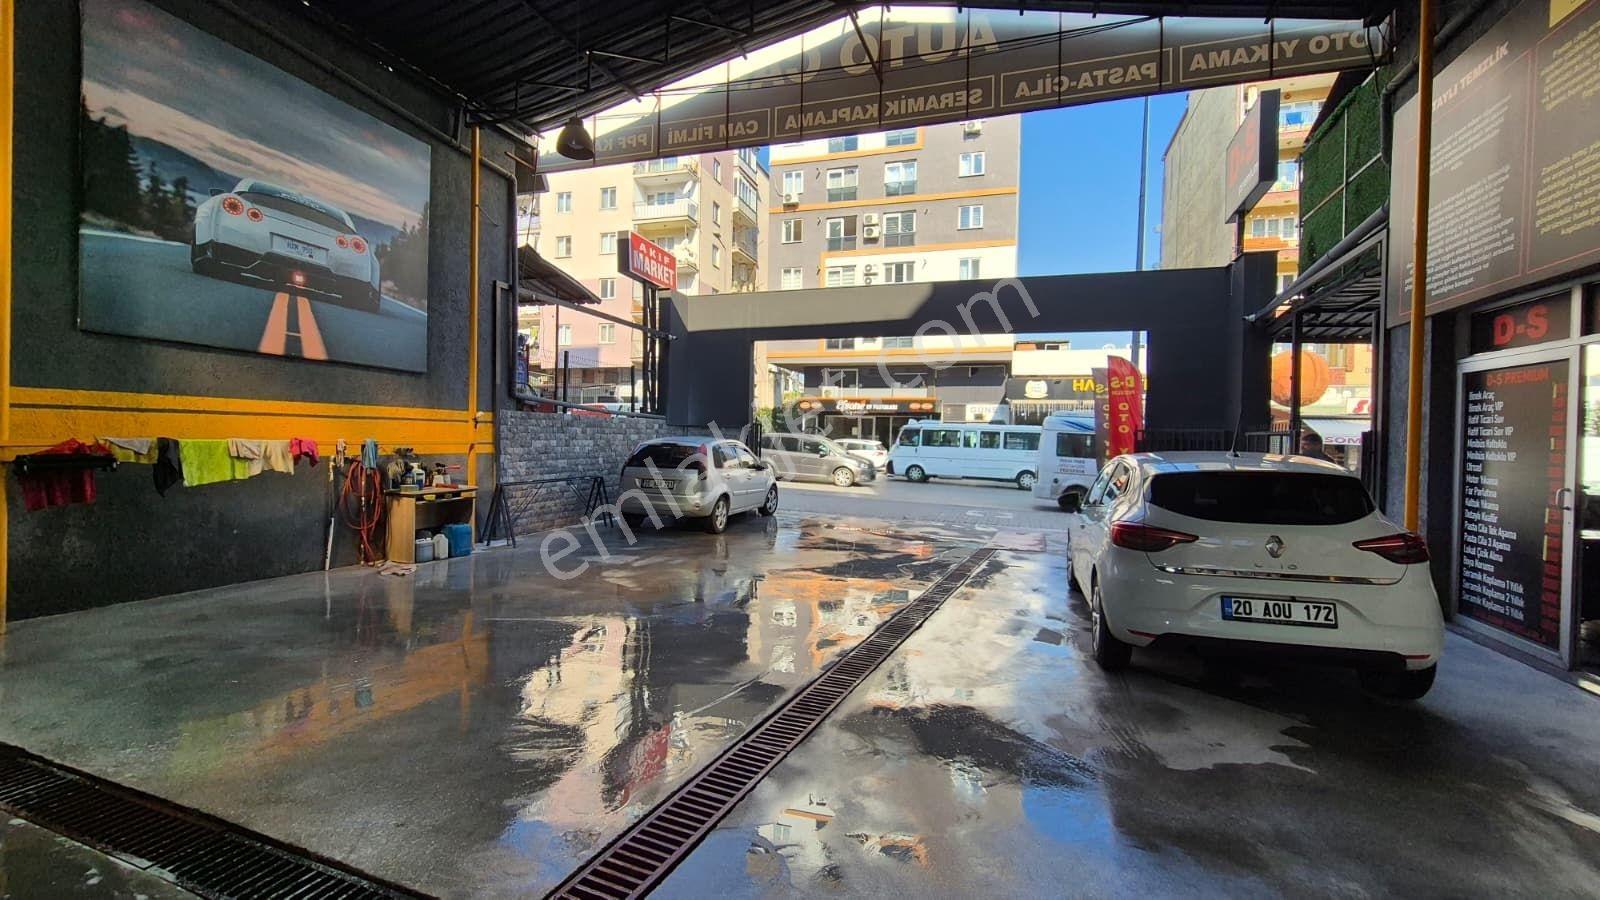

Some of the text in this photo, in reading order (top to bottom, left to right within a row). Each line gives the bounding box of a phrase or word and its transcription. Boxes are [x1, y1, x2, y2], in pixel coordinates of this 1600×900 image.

[633, 250, 674, 287] MARKET
[1494, 306, 1550, 346] D-S
[1233, 600, 1334, 622] 20 AOU 172
